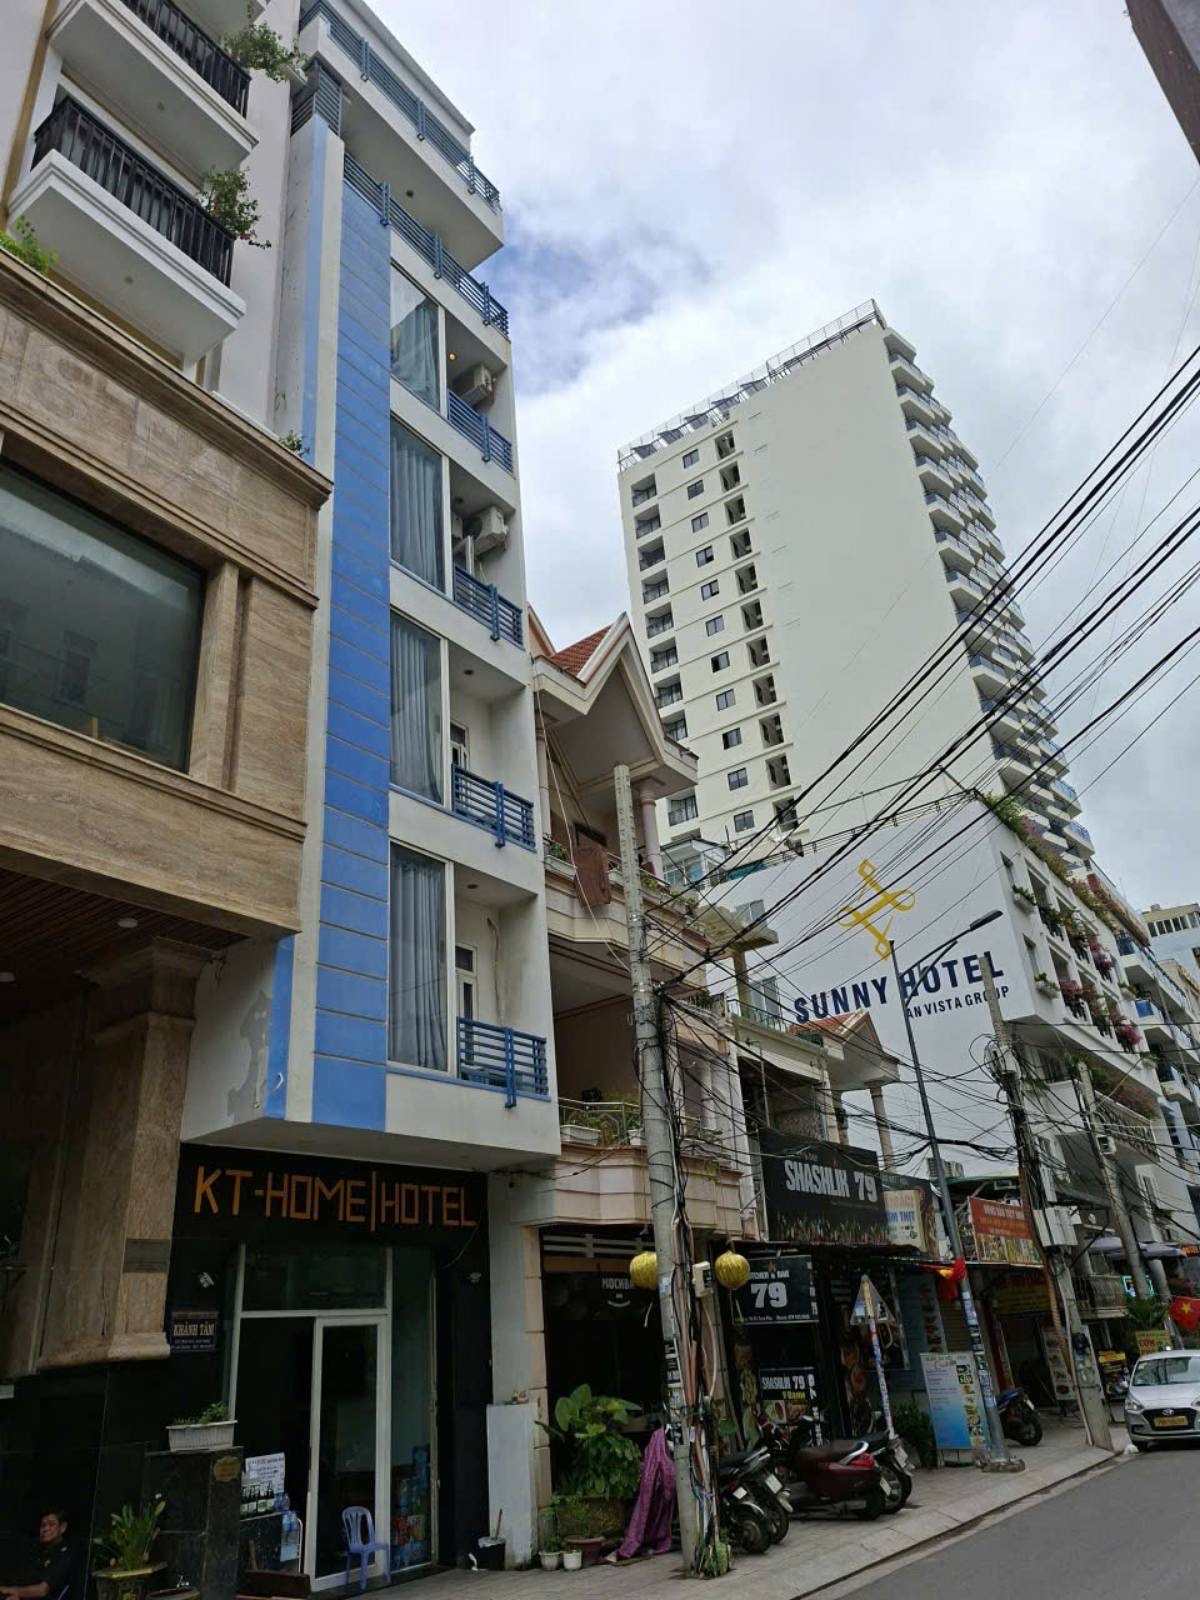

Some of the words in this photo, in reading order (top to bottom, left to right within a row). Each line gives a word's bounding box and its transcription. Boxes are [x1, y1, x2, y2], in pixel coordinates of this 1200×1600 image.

[793, 976, 888, 1024] SUNNY
[900, 951, 1004, 1000] HOTEL
[924, 997, 963, 1016] VISTA
[784, 1159, 850, 1198] SHASHLIK
[854, 1171, 878, 1203] 79
[381, 1181, 478, 1227] HOTEL
[751, 1281, 788, 1308] 79
[792, 1375, 806, 1390] 79
